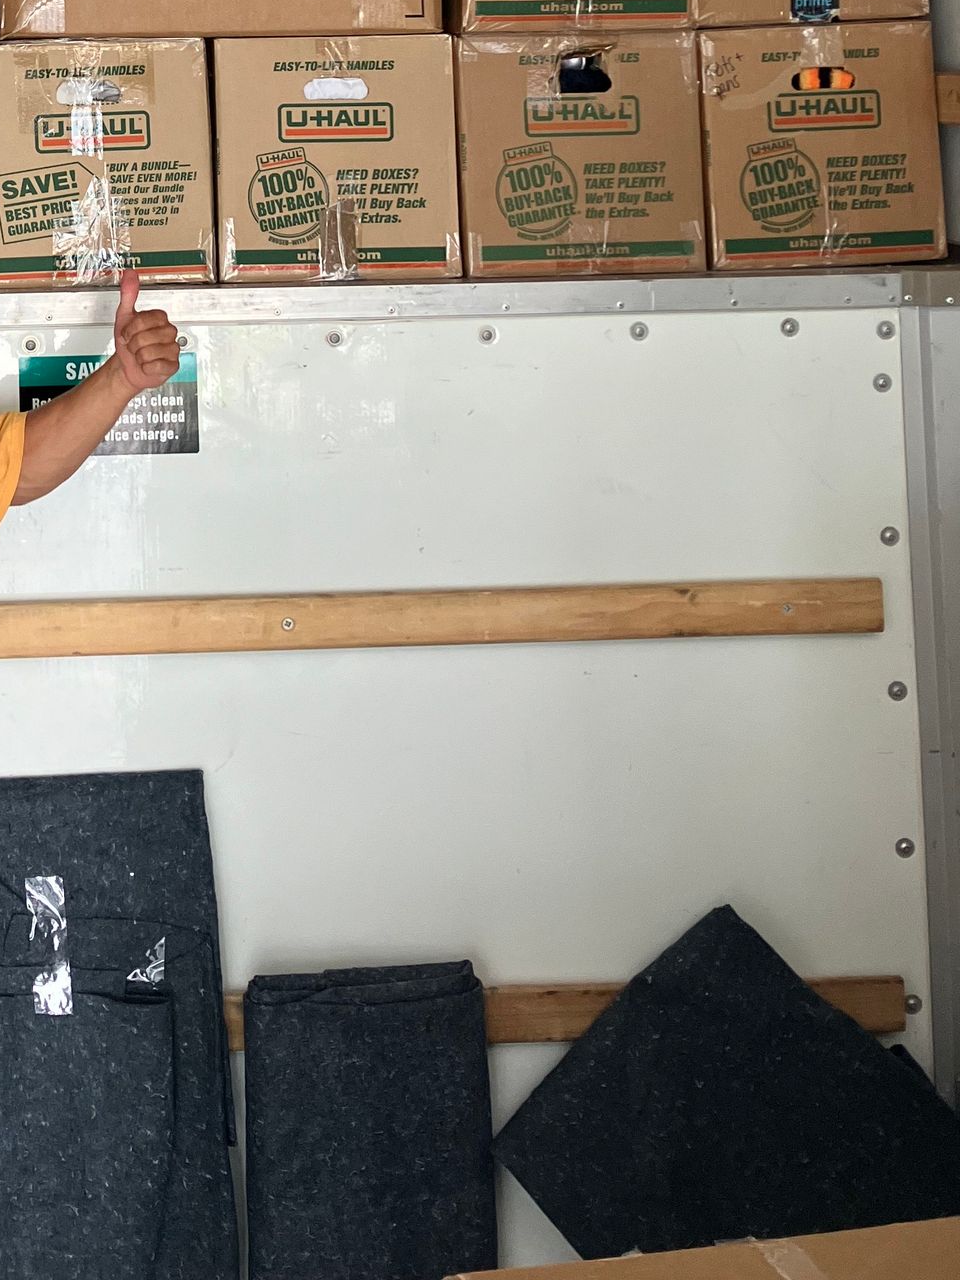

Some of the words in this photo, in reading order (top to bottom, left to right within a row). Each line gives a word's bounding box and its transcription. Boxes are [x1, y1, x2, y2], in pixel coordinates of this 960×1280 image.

[273, 61, 344, 72] EASY-TO-LIFT
[346, 60, 395, 71] HANDLES
[775, 97, 874, 117] U-HAUL
[286, 109, 387, 127] U-HAUL
[260, 150, 302, 165] U-HAUL
[826, 156, 858, 168] NEED
[861, 154, 907, 167] BOXES?
[131, 162, 138, 172] A
[583, 163, 615, 175] NEED
[619, 161, 666, 174] BOXES?
[749, 155, 806, 187] 100%
[110, 174, 134, 184] SAVE
[137, 173, 162, 183] EVEN
[164, 172, 197, 182] MORE!
[336, 169, 368, 181] NEED
[372, 168, 419, 180] BOXES?
[505, 161, 563, 193] 100%
[828, 170, 857, 182] TAKE
[860, 168, 907, 181] PLENTY!
[1, 170, 78, 199] SAVE!
[258, 166, 315, 198] 100%
[337, 183, 367, 195] TAKE
[370, 183, 418, 195] PLENTY!
[585, 177, 615, 189] TAKE
[618, 176, 666, 188] PLENTY!
[111, 185, 131, 195] Beat
[133, 185, 150, 194] Our
[152, 184, 184, 193] Bundle
[748, 179, 815, 206] BUY-BACK
[860, 184, 883, 197] Buy
[885, 182, 914, 194] Back
[141, 195, 159, 204] and
[162, 194, 184, 204] We'll
[256, 191, 325, 218] BUY-BACK
[370, 198, 394, 211] Buy
[397, 197, 426, 209] Back
[503, 185, 573, 213] BUY-BACK
[585, 192, 614, 204] We'll
[618, 192, 641, 205] Buy
[644, 190, 674, 202] Back
[851, 198, 891, 210] Extras.
[5, 206, 38, 222] BEST
[134, 207, 150, 216] You
[152, 206, 167, 215] $20
[170, 206, 179, 215] in
[361, 212, 402, 224] Extras.
[585, 207, 605, 219] the
[608, 207, 650, 218] Extras.
[137, 217, 169, 227] Boxes!
[150, 395, 184, 407] clean
[147, 410, 185, 423] folded
[133, 428, 179, 443] charge.
